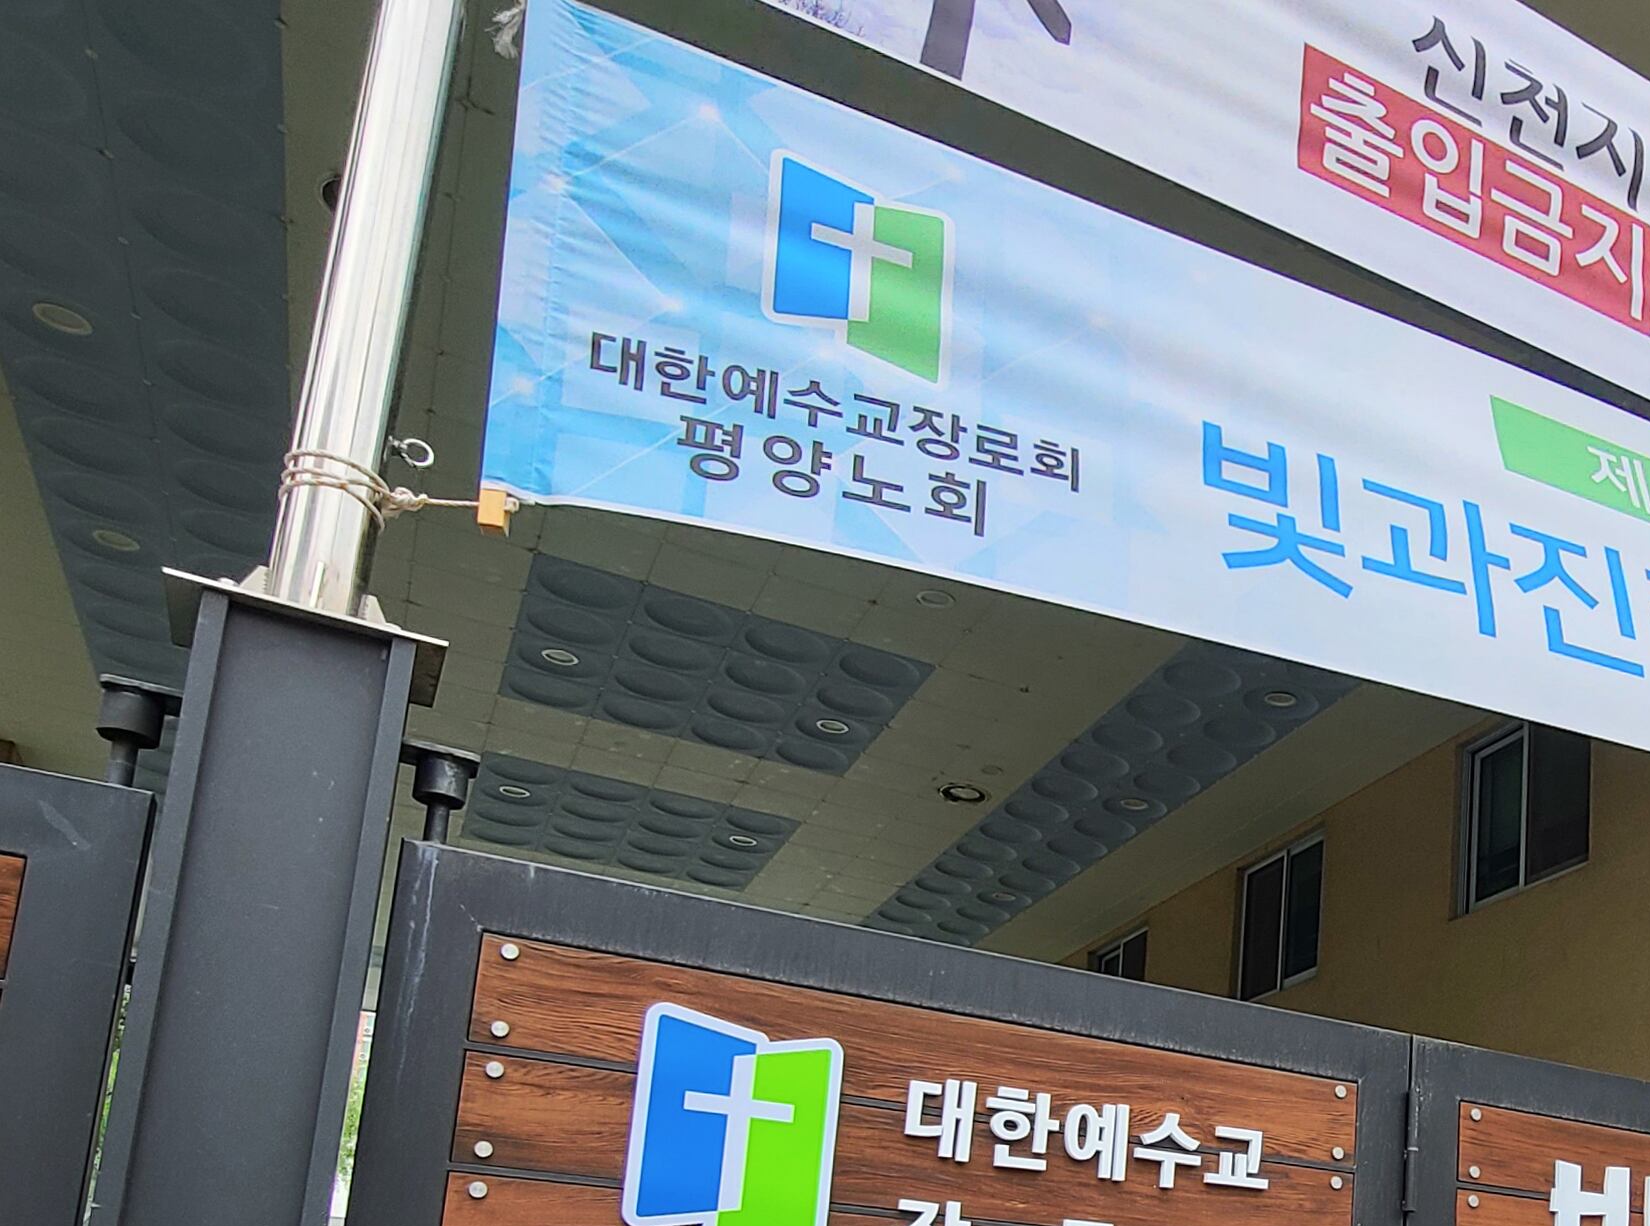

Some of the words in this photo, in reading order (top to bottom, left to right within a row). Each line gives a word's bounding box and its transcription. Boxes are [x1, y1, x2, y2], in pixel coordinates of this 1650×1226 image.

[1412, 16, 1646, 213] 신천지
[1310, 72, 1644, 321] 출입금지
[589, 330, 1082, 492] 대한예수교장로회
[676, 414, 989, 537] 평양노회
[904, 1079, 1270, 1190] 대한예수교
